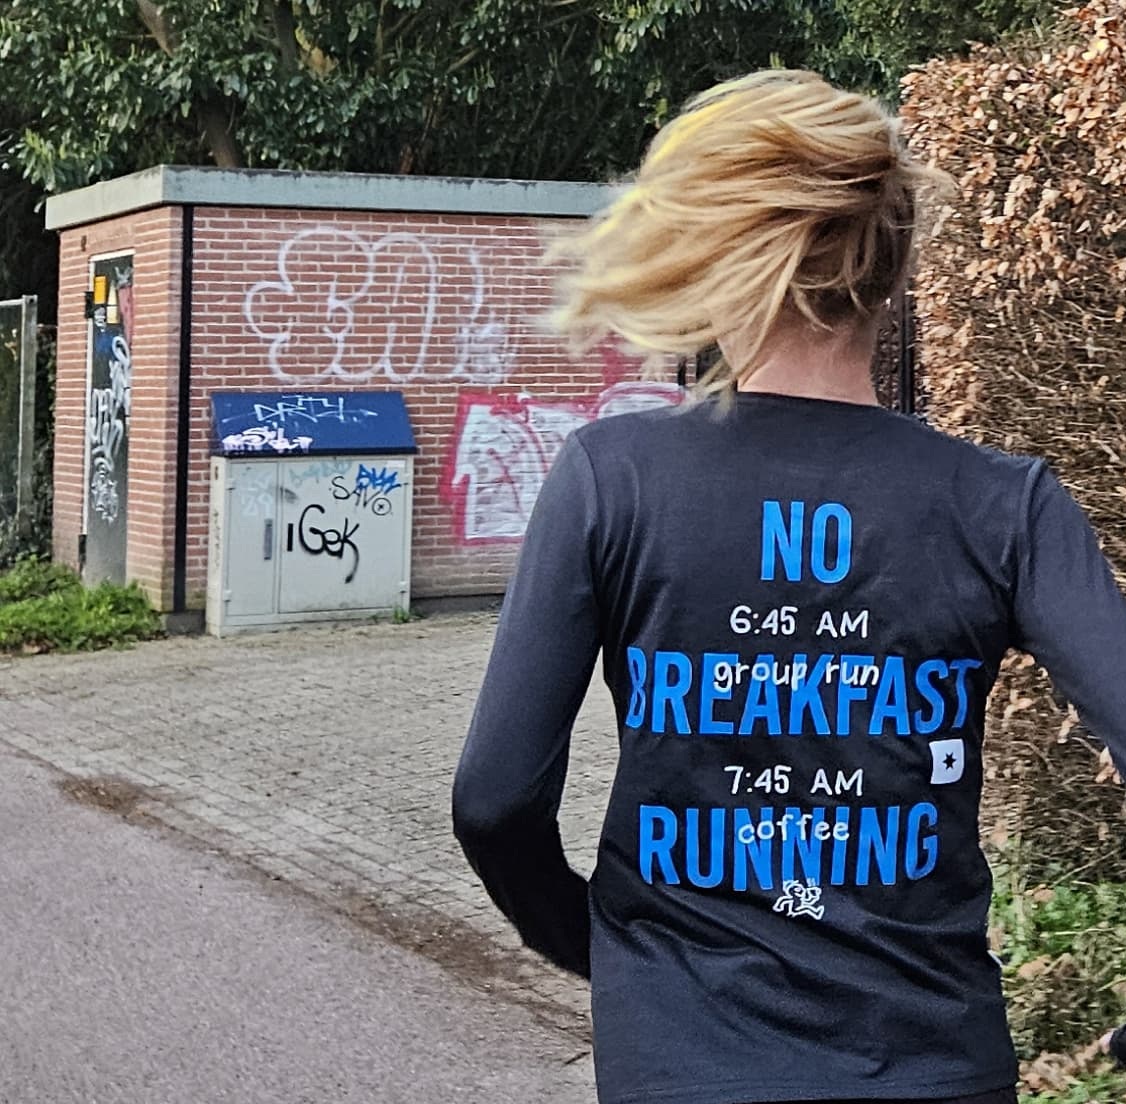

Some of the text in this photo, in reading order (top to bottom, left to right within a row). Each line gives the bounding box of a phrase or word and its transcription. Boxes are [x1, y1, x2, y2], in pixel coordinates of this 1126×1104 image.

[760, 500, 853, 584] NO
[729, 605, 869, 638] 6:45 AM
[625, 646, 982, 736] BREAKFAST
[713, 661, 880, 693] group run
[724, 765, 863, 797] 7:45 AM
[736, 812, 850, 845] coffee
[638, 801, 938, 891] RUNNING
